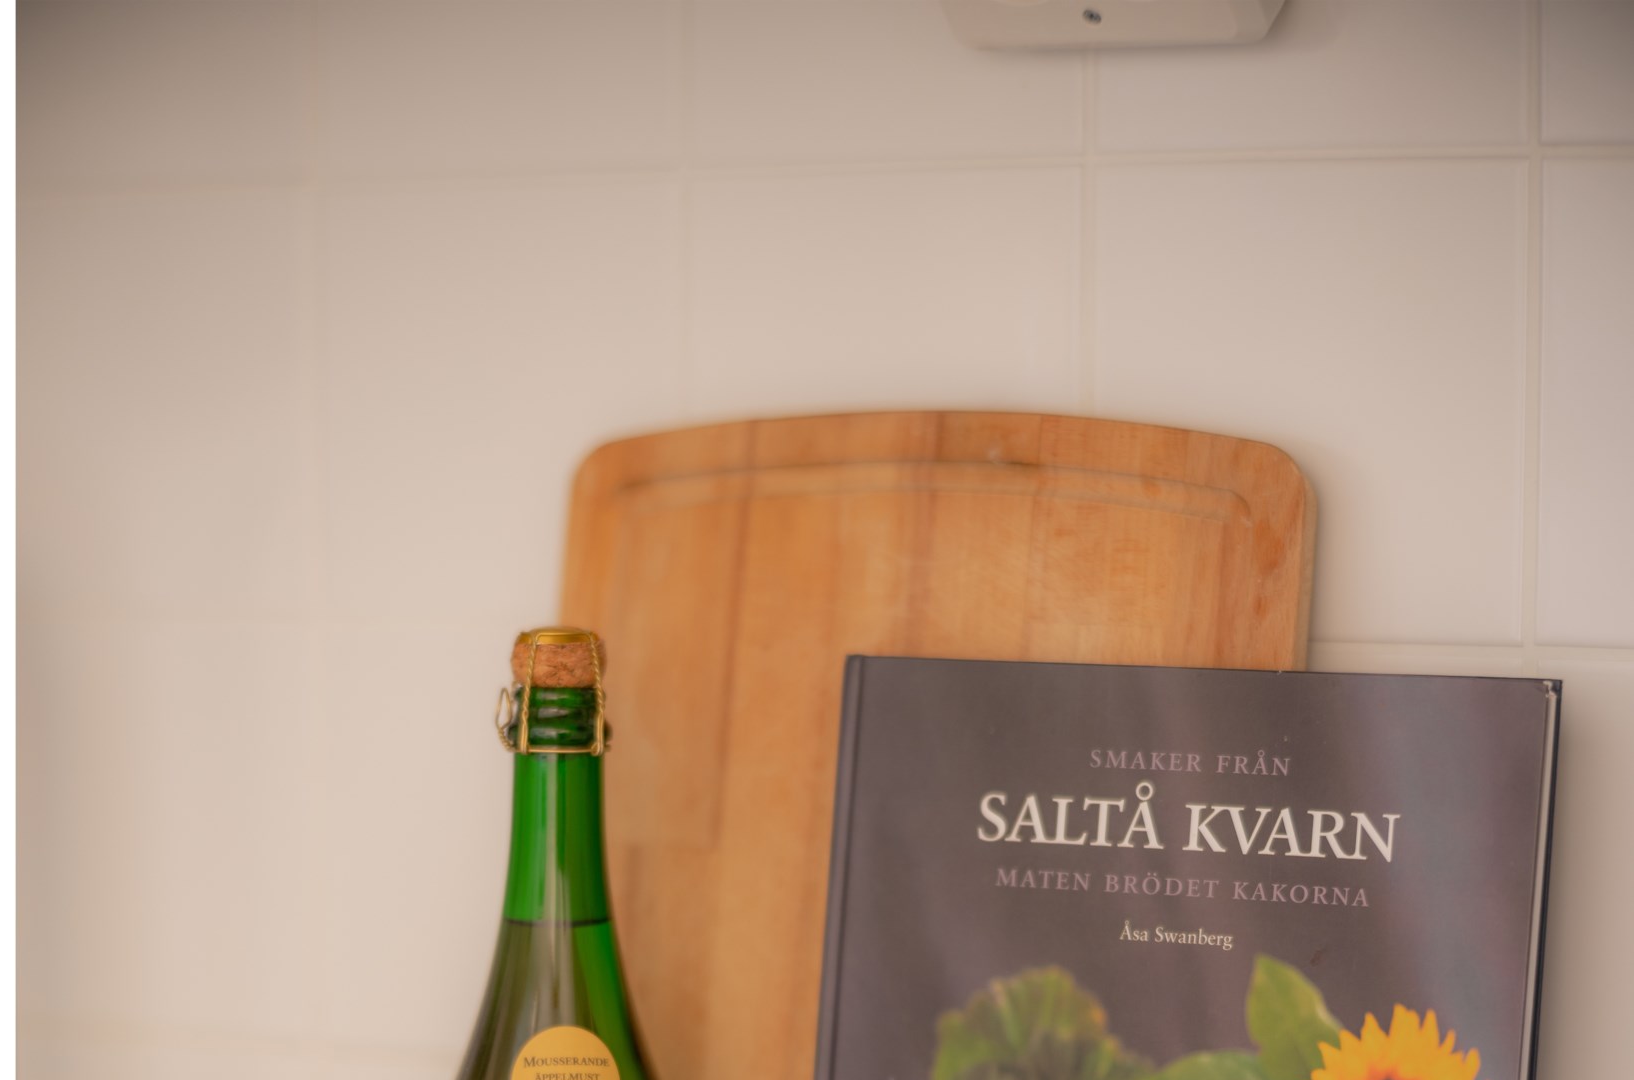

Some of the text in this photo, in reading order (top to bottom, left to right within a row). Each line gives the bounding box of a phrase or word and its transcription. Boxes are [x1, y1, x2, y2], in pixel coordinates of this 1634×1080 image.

[1089, 749, 1292, 777] SMAKER FRÅN
[977, 781, 1401, 863] SALTÅ KVARN
[995, 867, 1370, 908] MATEN BRÖDET KAKORNA
[1119, 921, 1235, 951] Åsa Swanberg
[524, 1056, 609, 1067] MOUSSERANDE
